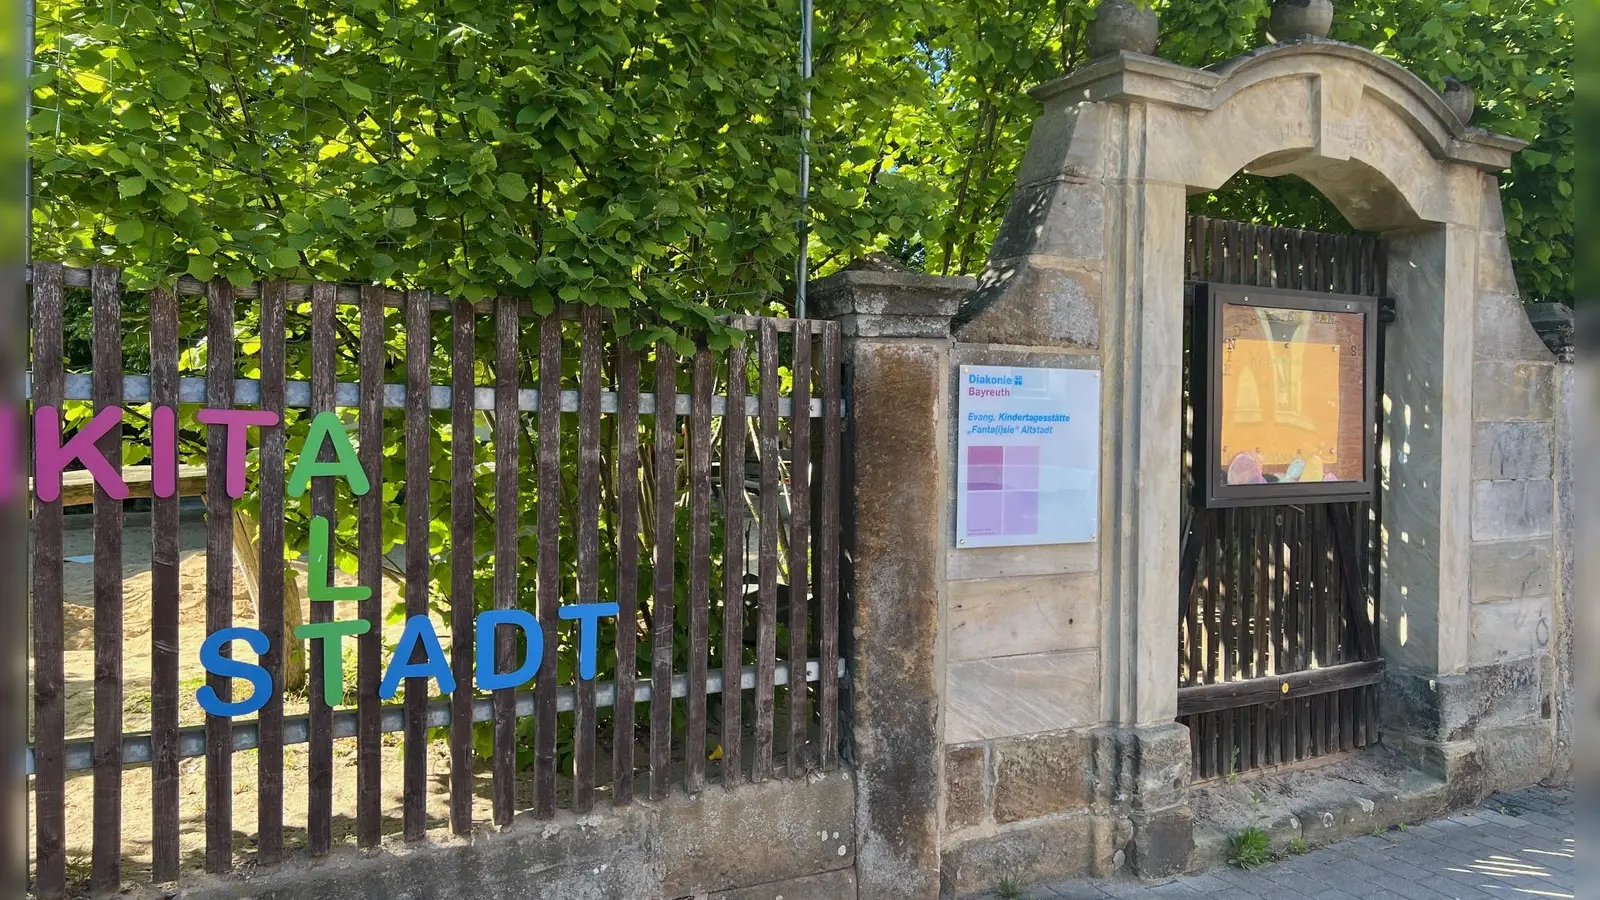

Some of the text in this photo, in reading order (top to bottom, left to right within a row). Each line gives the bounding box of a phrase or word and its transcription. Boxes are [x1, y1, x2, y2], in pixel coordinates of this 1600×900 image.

[968, 374, 1013, 385] Diakonie
[968, 386, 1011, 398] Bayreuth
[967, 412, 1070, 423] Evang. Kindertagesstätte
[1020, 425, 1053, 434] Altstadt
[34, 405, 370, 502] KITA
